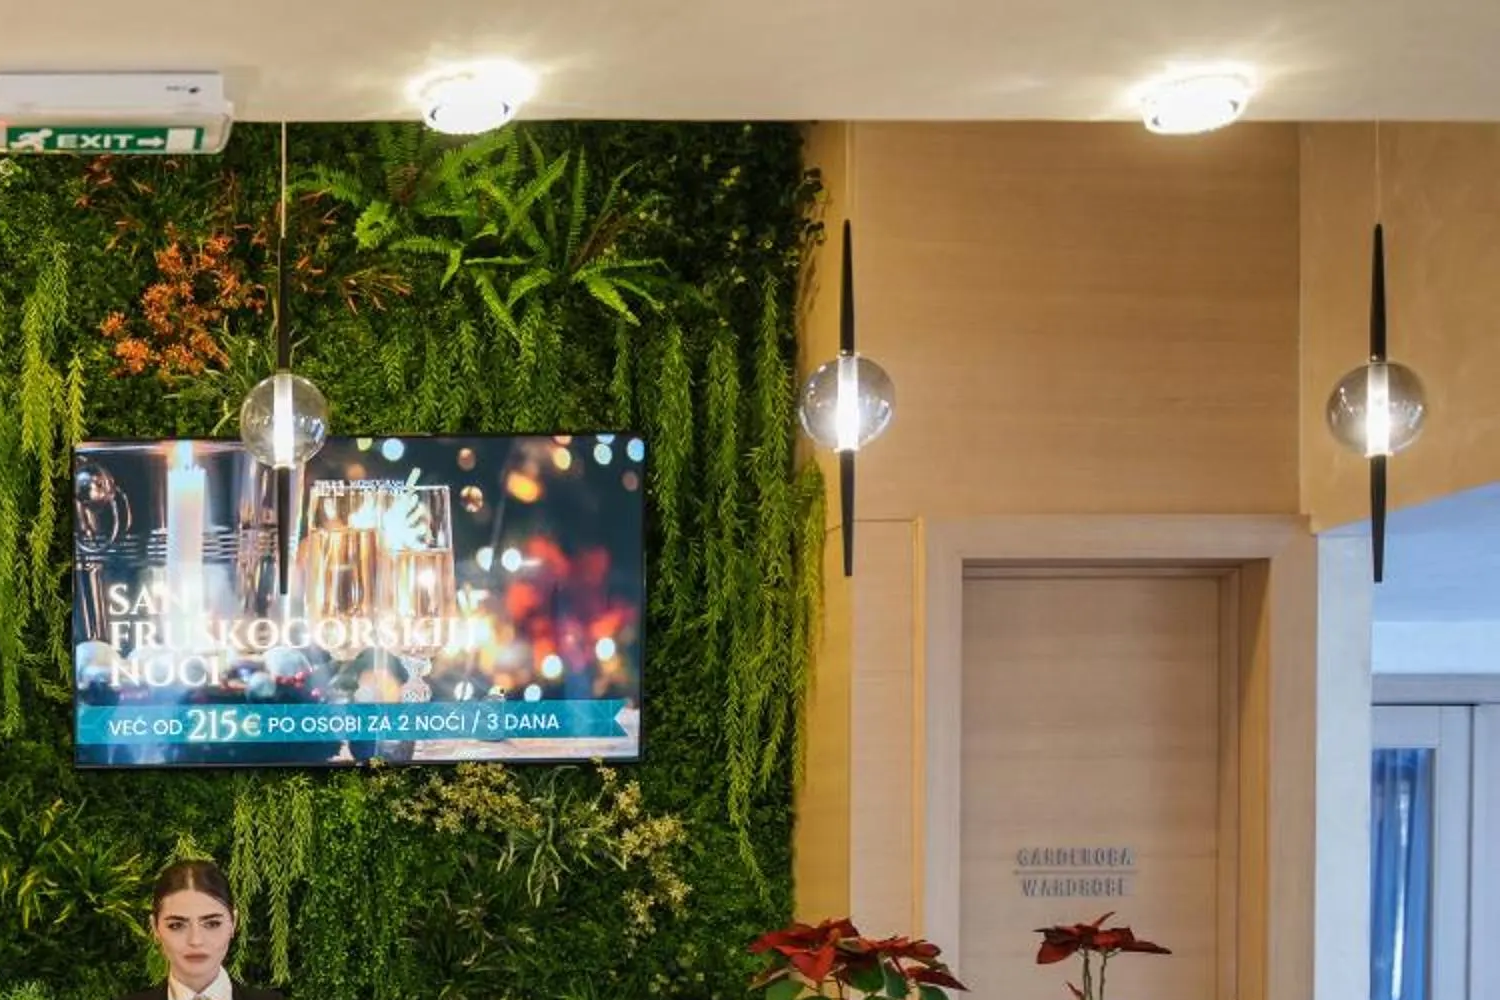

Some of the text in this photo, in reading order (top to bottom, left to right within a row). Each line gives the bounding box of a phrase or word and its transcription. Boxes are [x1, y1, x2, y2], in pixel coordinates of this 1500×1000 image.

[56, 134, 134, 149] EXIT
[108, 709, 560, 742] VEĆ OD 215€ PO OSOBI ZA 2 NOĆI / 3 DANA
[1016, 847, 1134, 866] GARDEROBA
[1022, 878, 1124, 897] WARDROBE
